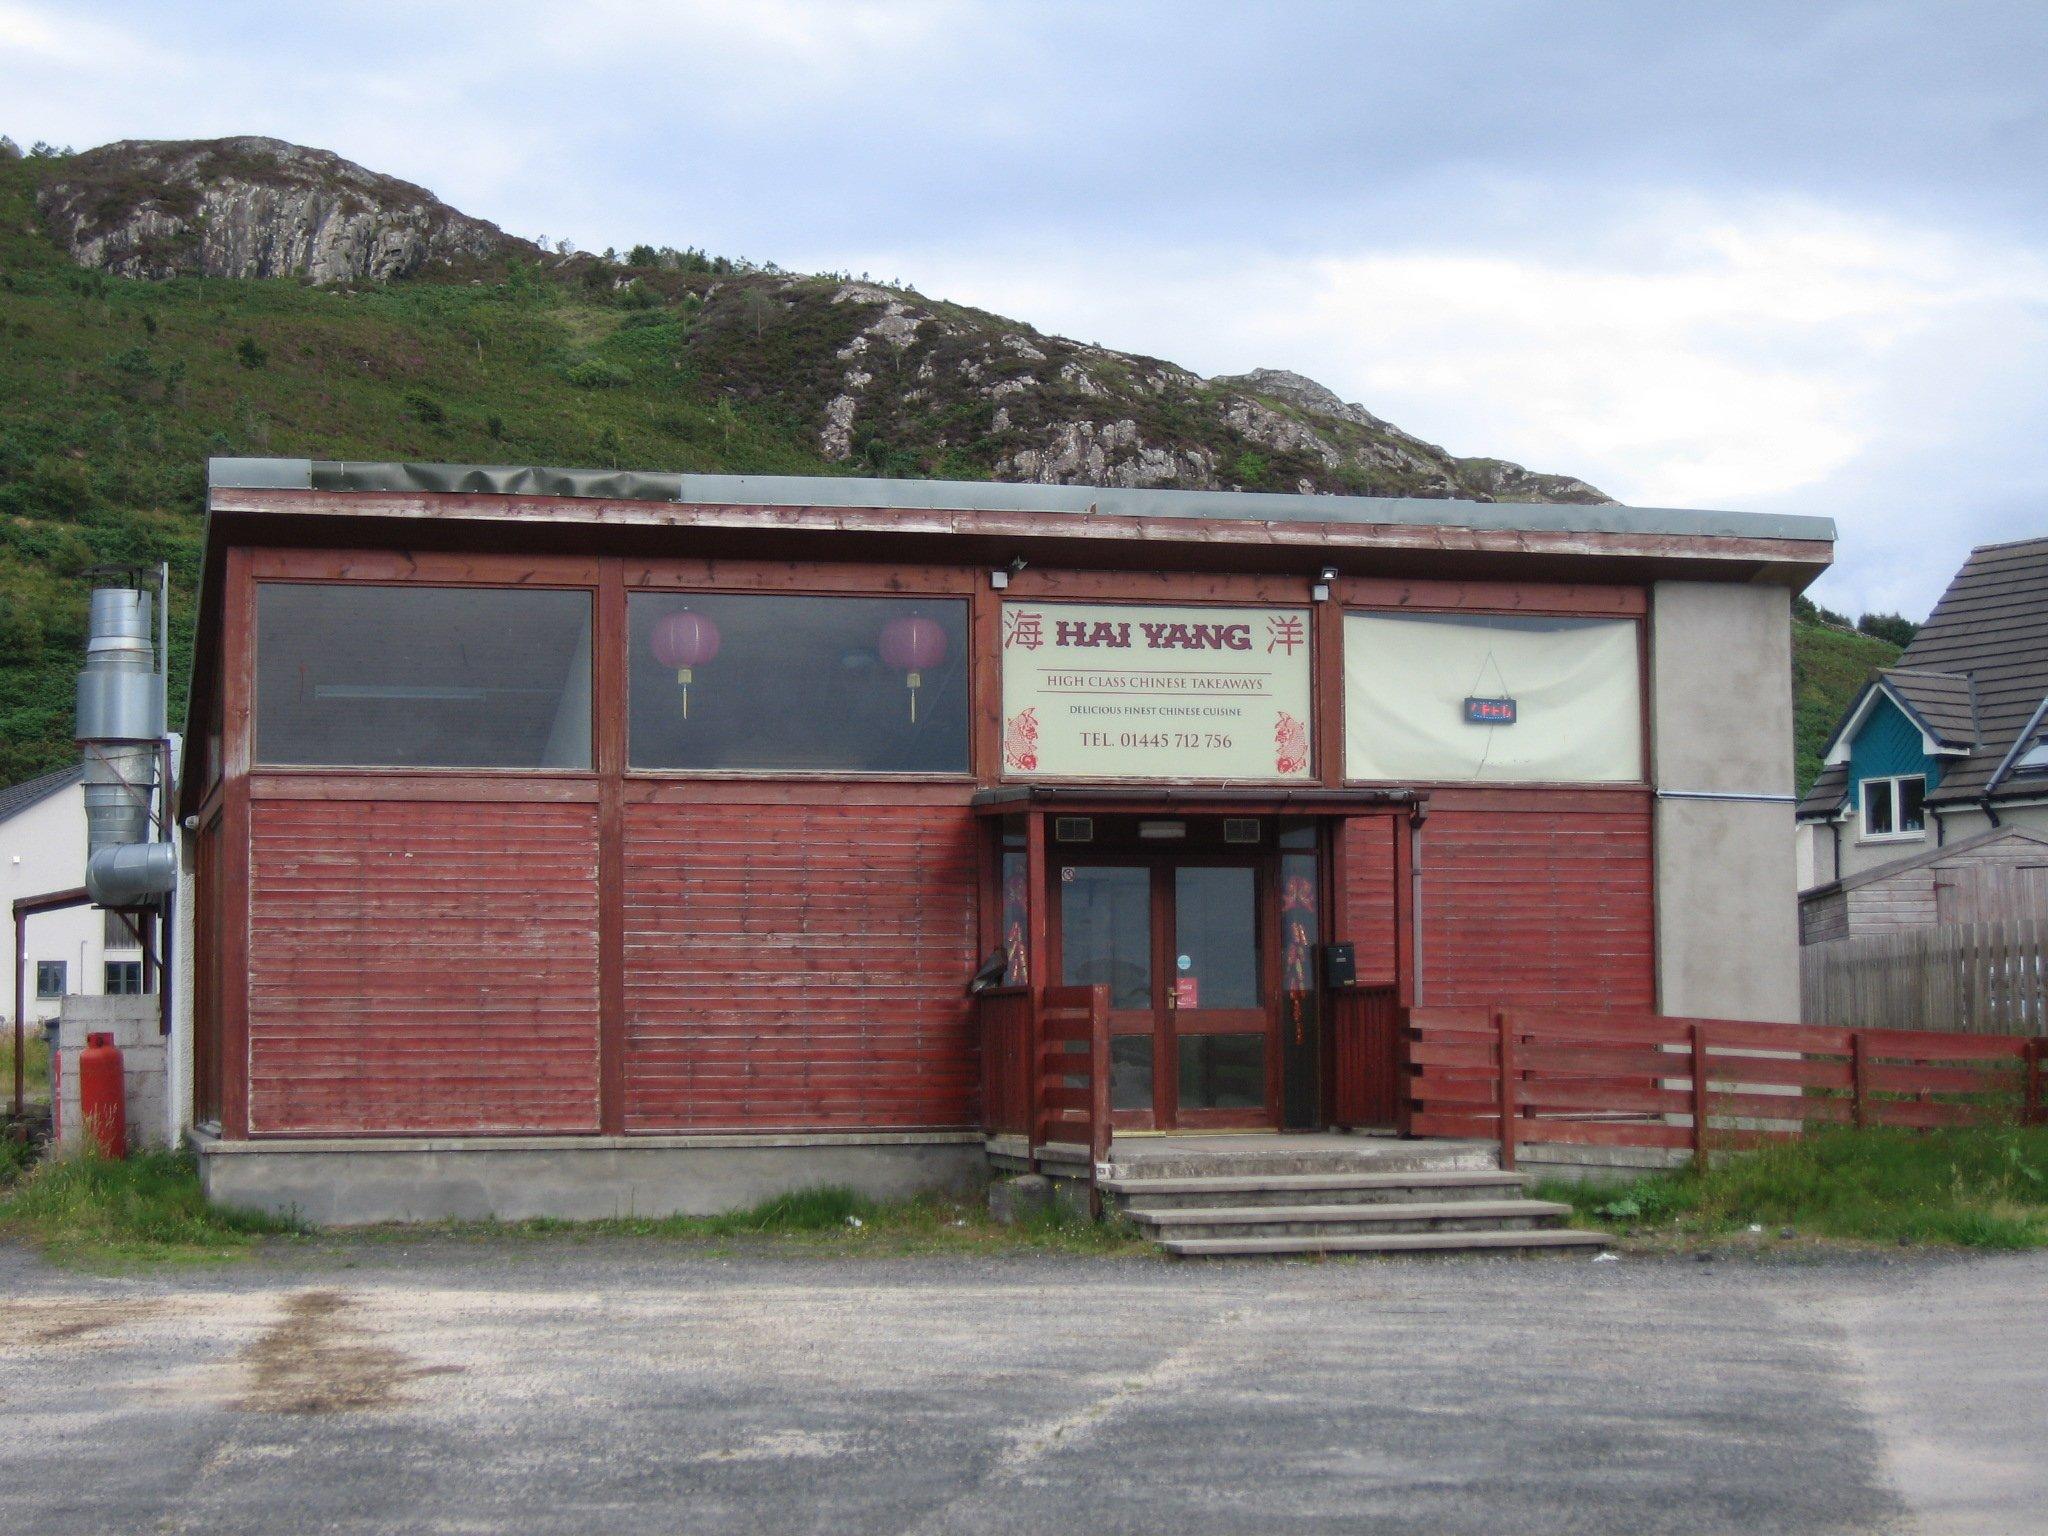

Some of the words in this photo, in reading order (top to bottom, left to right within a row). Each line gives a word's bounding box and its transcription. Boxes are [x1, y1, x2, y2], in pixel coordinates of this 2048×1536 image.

[1004, 609, 1043, 651] 海
[1056, 620, 1131, 648] HAI
[1139, 622, 1253, 650] YANG
[1266, 615, 1304, 656] 洋
[1047, 675, 1084, 687] HIGH
[1088, 676, 1126, 688] CLASS
[1129, 677, 1187, 689] CHINESE
[1190, 678, 1263, 690] TAKEAWAYS
[1069, 705, 1122, 715] DELICIOUS
[1124, 706, 1157, 715] FINEST
[1159, 707, 1201, 716] CHINESE
[1202, 707, 1243, 717] CUISINE
[1079, 732, 1115, 747] TEL.
[1120, 733, 1169, 748] 01445
[1174, 733, 1199, 748] 712
[1205, 733, 1232, 749] 756
